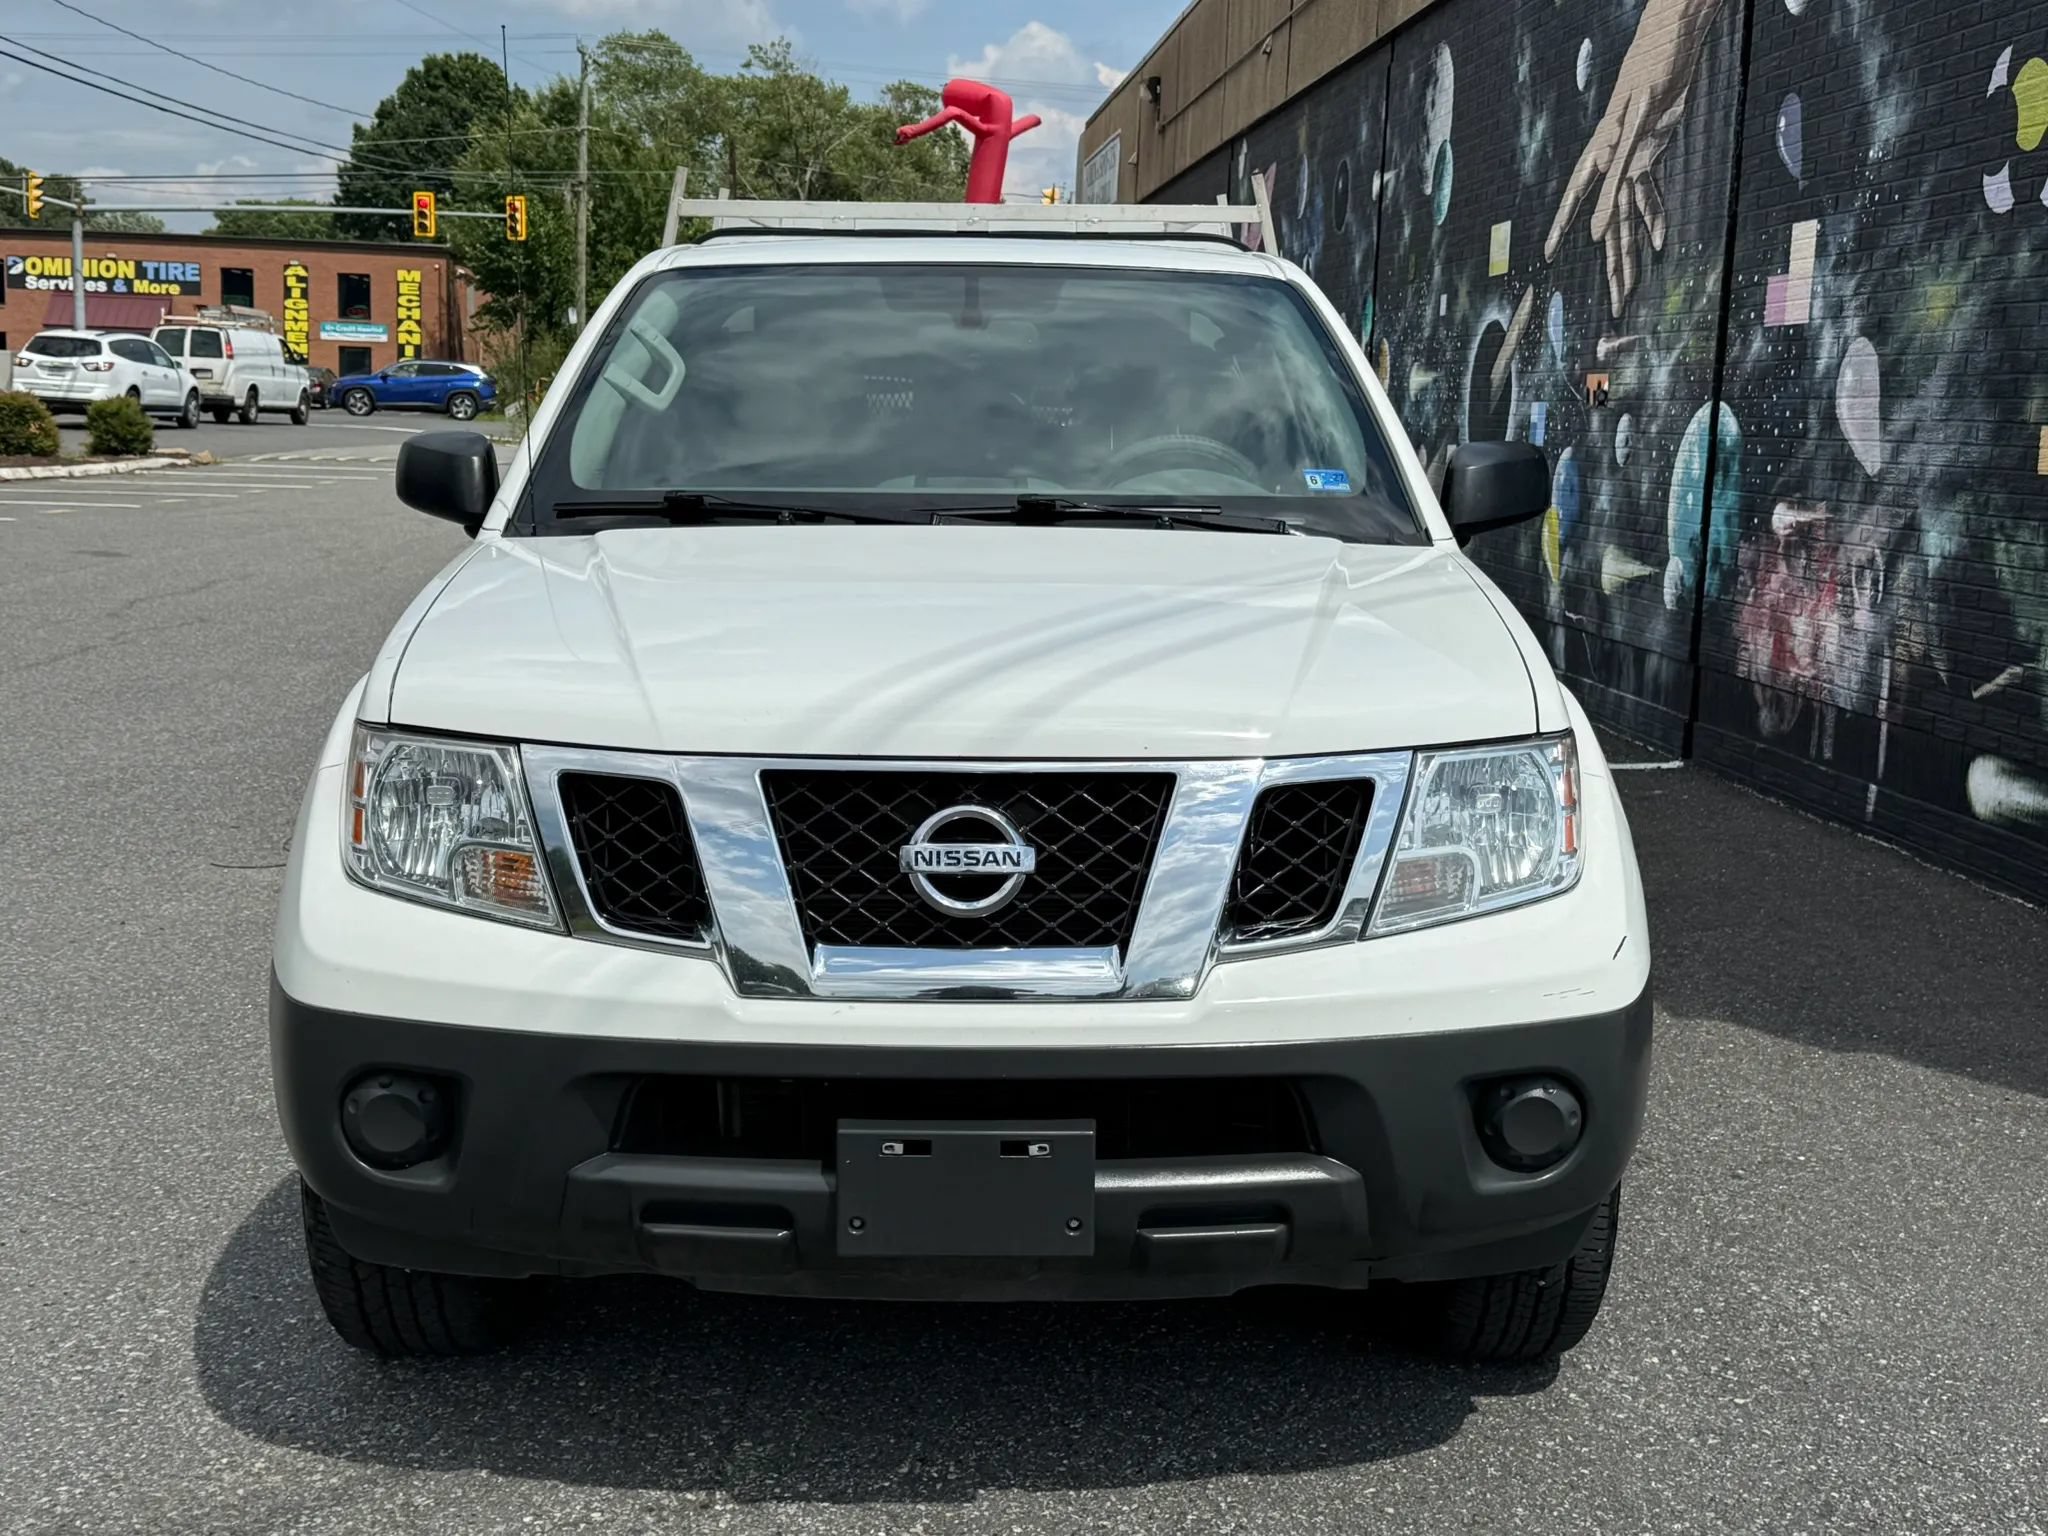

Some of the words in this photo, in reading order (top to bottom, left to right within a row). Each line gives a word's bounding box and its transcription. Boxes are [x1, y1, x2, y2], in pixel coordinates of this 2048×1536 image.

[142, 262, 200, 281] TIRE
[25, 276, 107, 292] Servies
[113, 279, 127, 293] &
[133, 280, 181, 295] More
[397, 270, 421, 361] MECHANI
[1310, 475, 1318, 485] 6
[914, 851, 1021, 867] NISSAN
